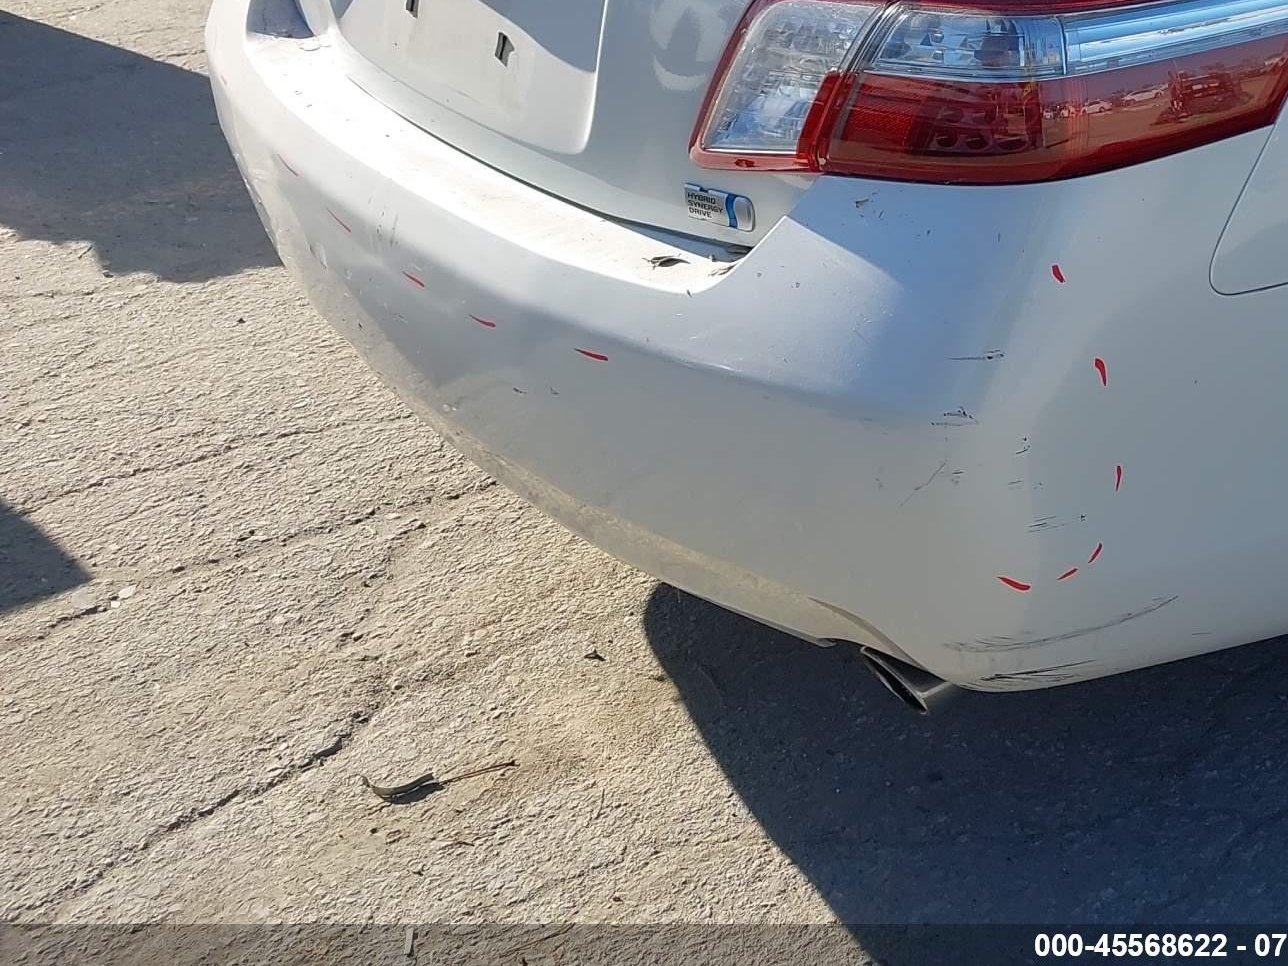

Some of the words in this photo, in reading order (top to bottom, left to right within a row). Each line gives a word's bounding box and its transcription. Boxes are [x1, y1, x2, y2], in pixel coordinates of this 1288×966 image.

[687, 191, 717, 205] HYBRID
[687, 199, 723, 214] SYNERGY
[688, 207, 713, 219] DRIVE
